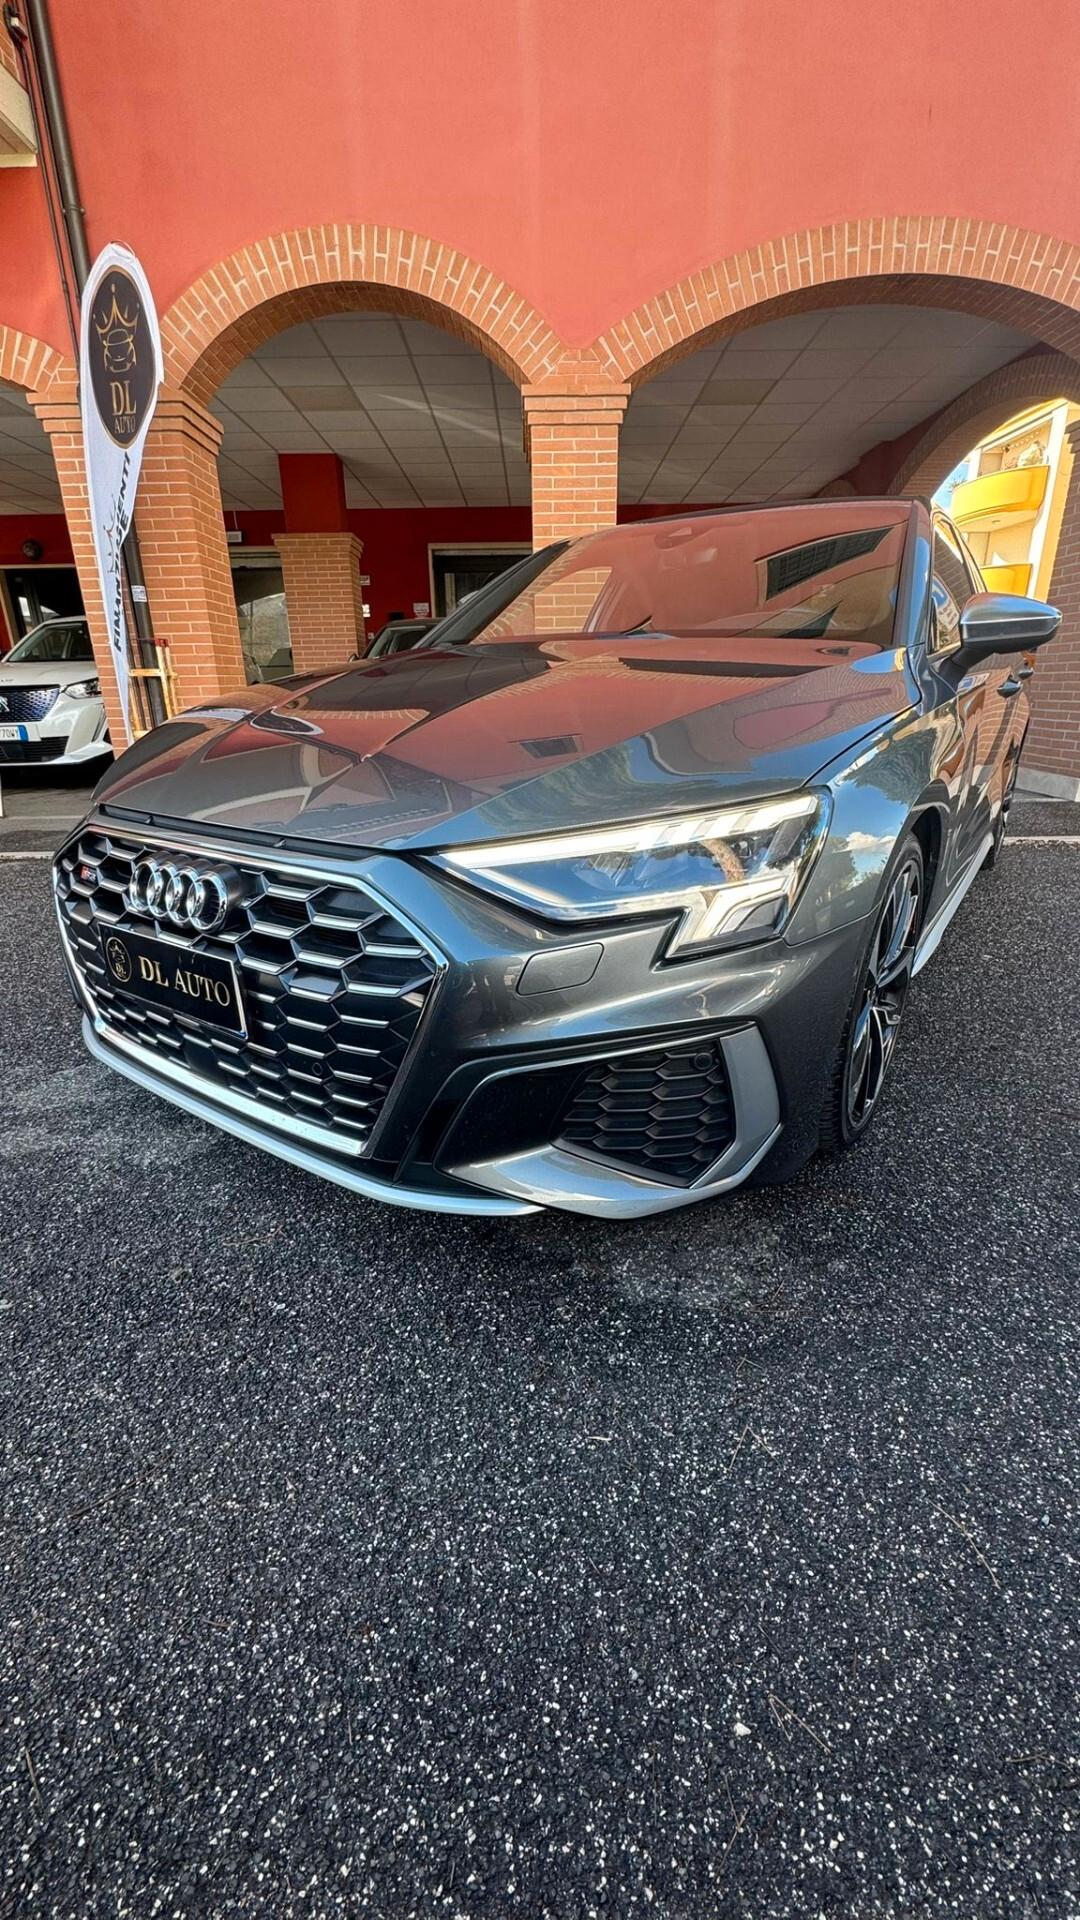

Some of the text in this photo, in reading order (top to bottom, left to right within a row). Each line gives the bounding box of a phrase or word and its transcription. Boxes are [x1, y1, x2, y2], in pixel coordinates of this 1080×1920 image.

[110, 381, 137, 416] DL
[114, 415, 136, 434] AUTO
[113, 451, 130, 653] FINANZIENTI
[138, 955, 231, 1007] DL AUTO
